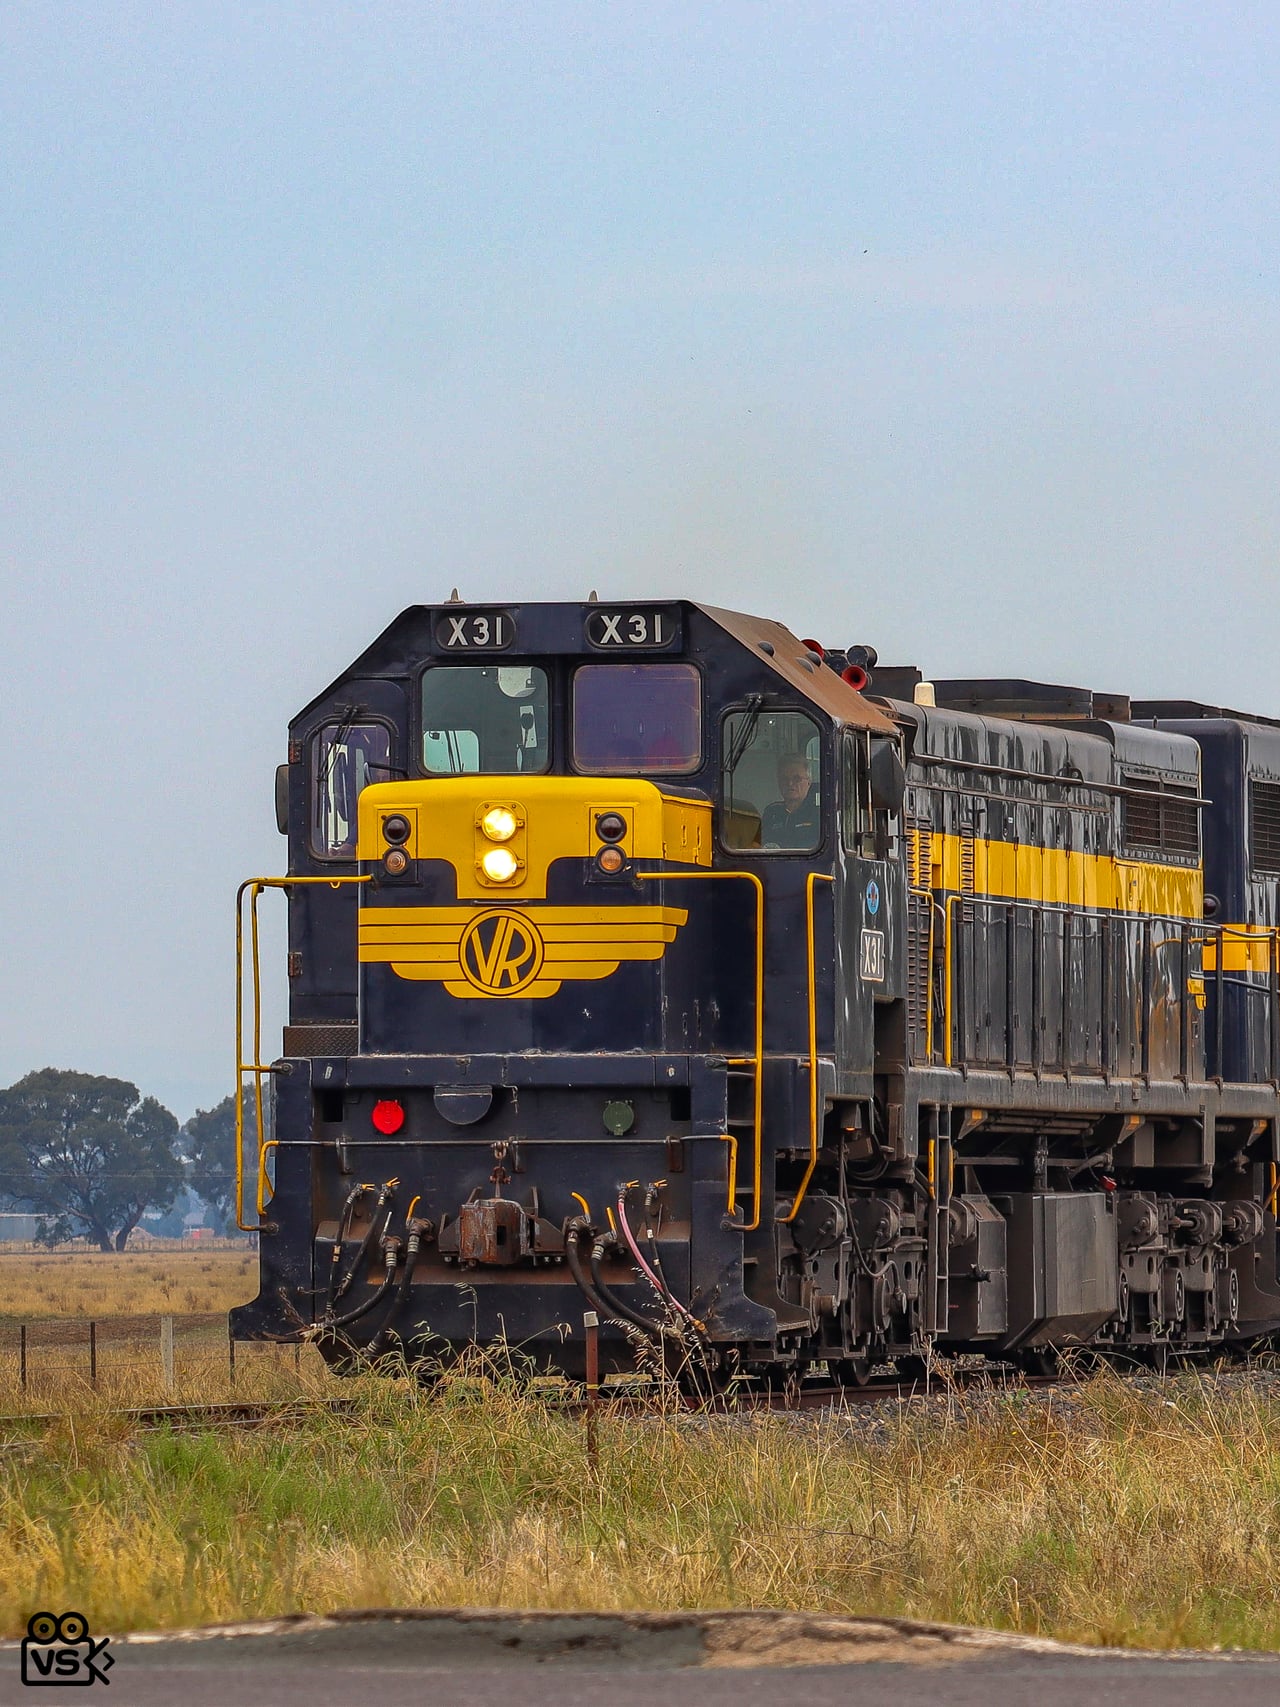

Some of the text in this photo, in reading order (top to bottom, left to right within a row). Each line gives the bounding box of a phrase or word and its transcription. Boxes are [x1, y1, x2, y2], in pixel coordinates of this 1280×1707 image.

[448, 617, 502, 646] X31
[600, 614, 662, 644] X31
[471, 917, 533, 987] VR
[864, 935, 881, 975] X31
